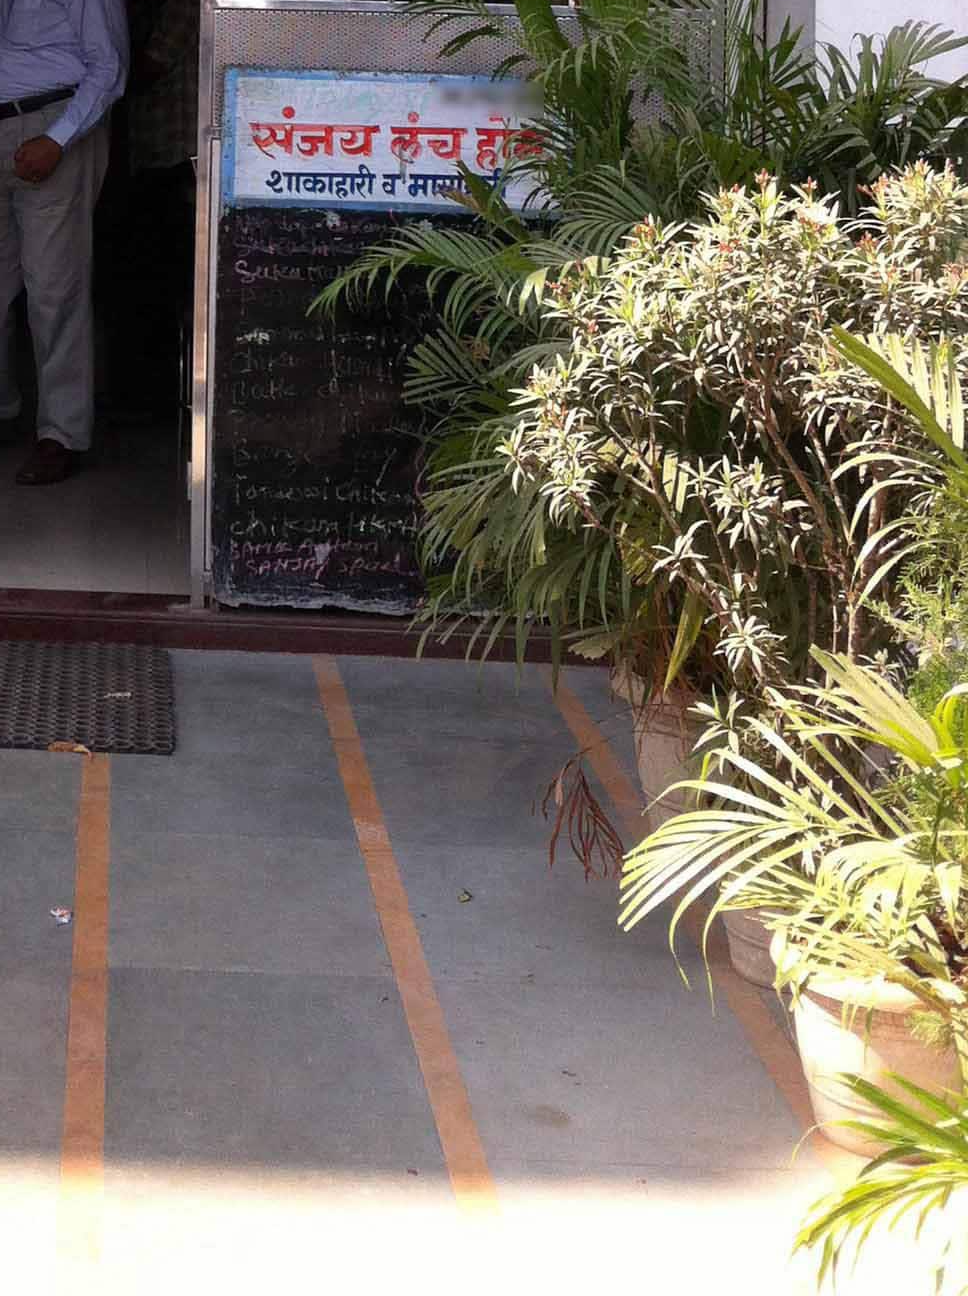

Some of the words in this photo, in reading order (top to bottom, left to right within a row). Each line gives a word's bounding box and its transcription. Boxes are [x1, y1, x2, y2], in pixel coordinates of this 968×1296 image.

[248, 106, 380, 159] संजय
[390, 112, 468, 164] लंच
[265, 164, 376, 198] शाकाहारी
[382, 171, 403, 196] व
